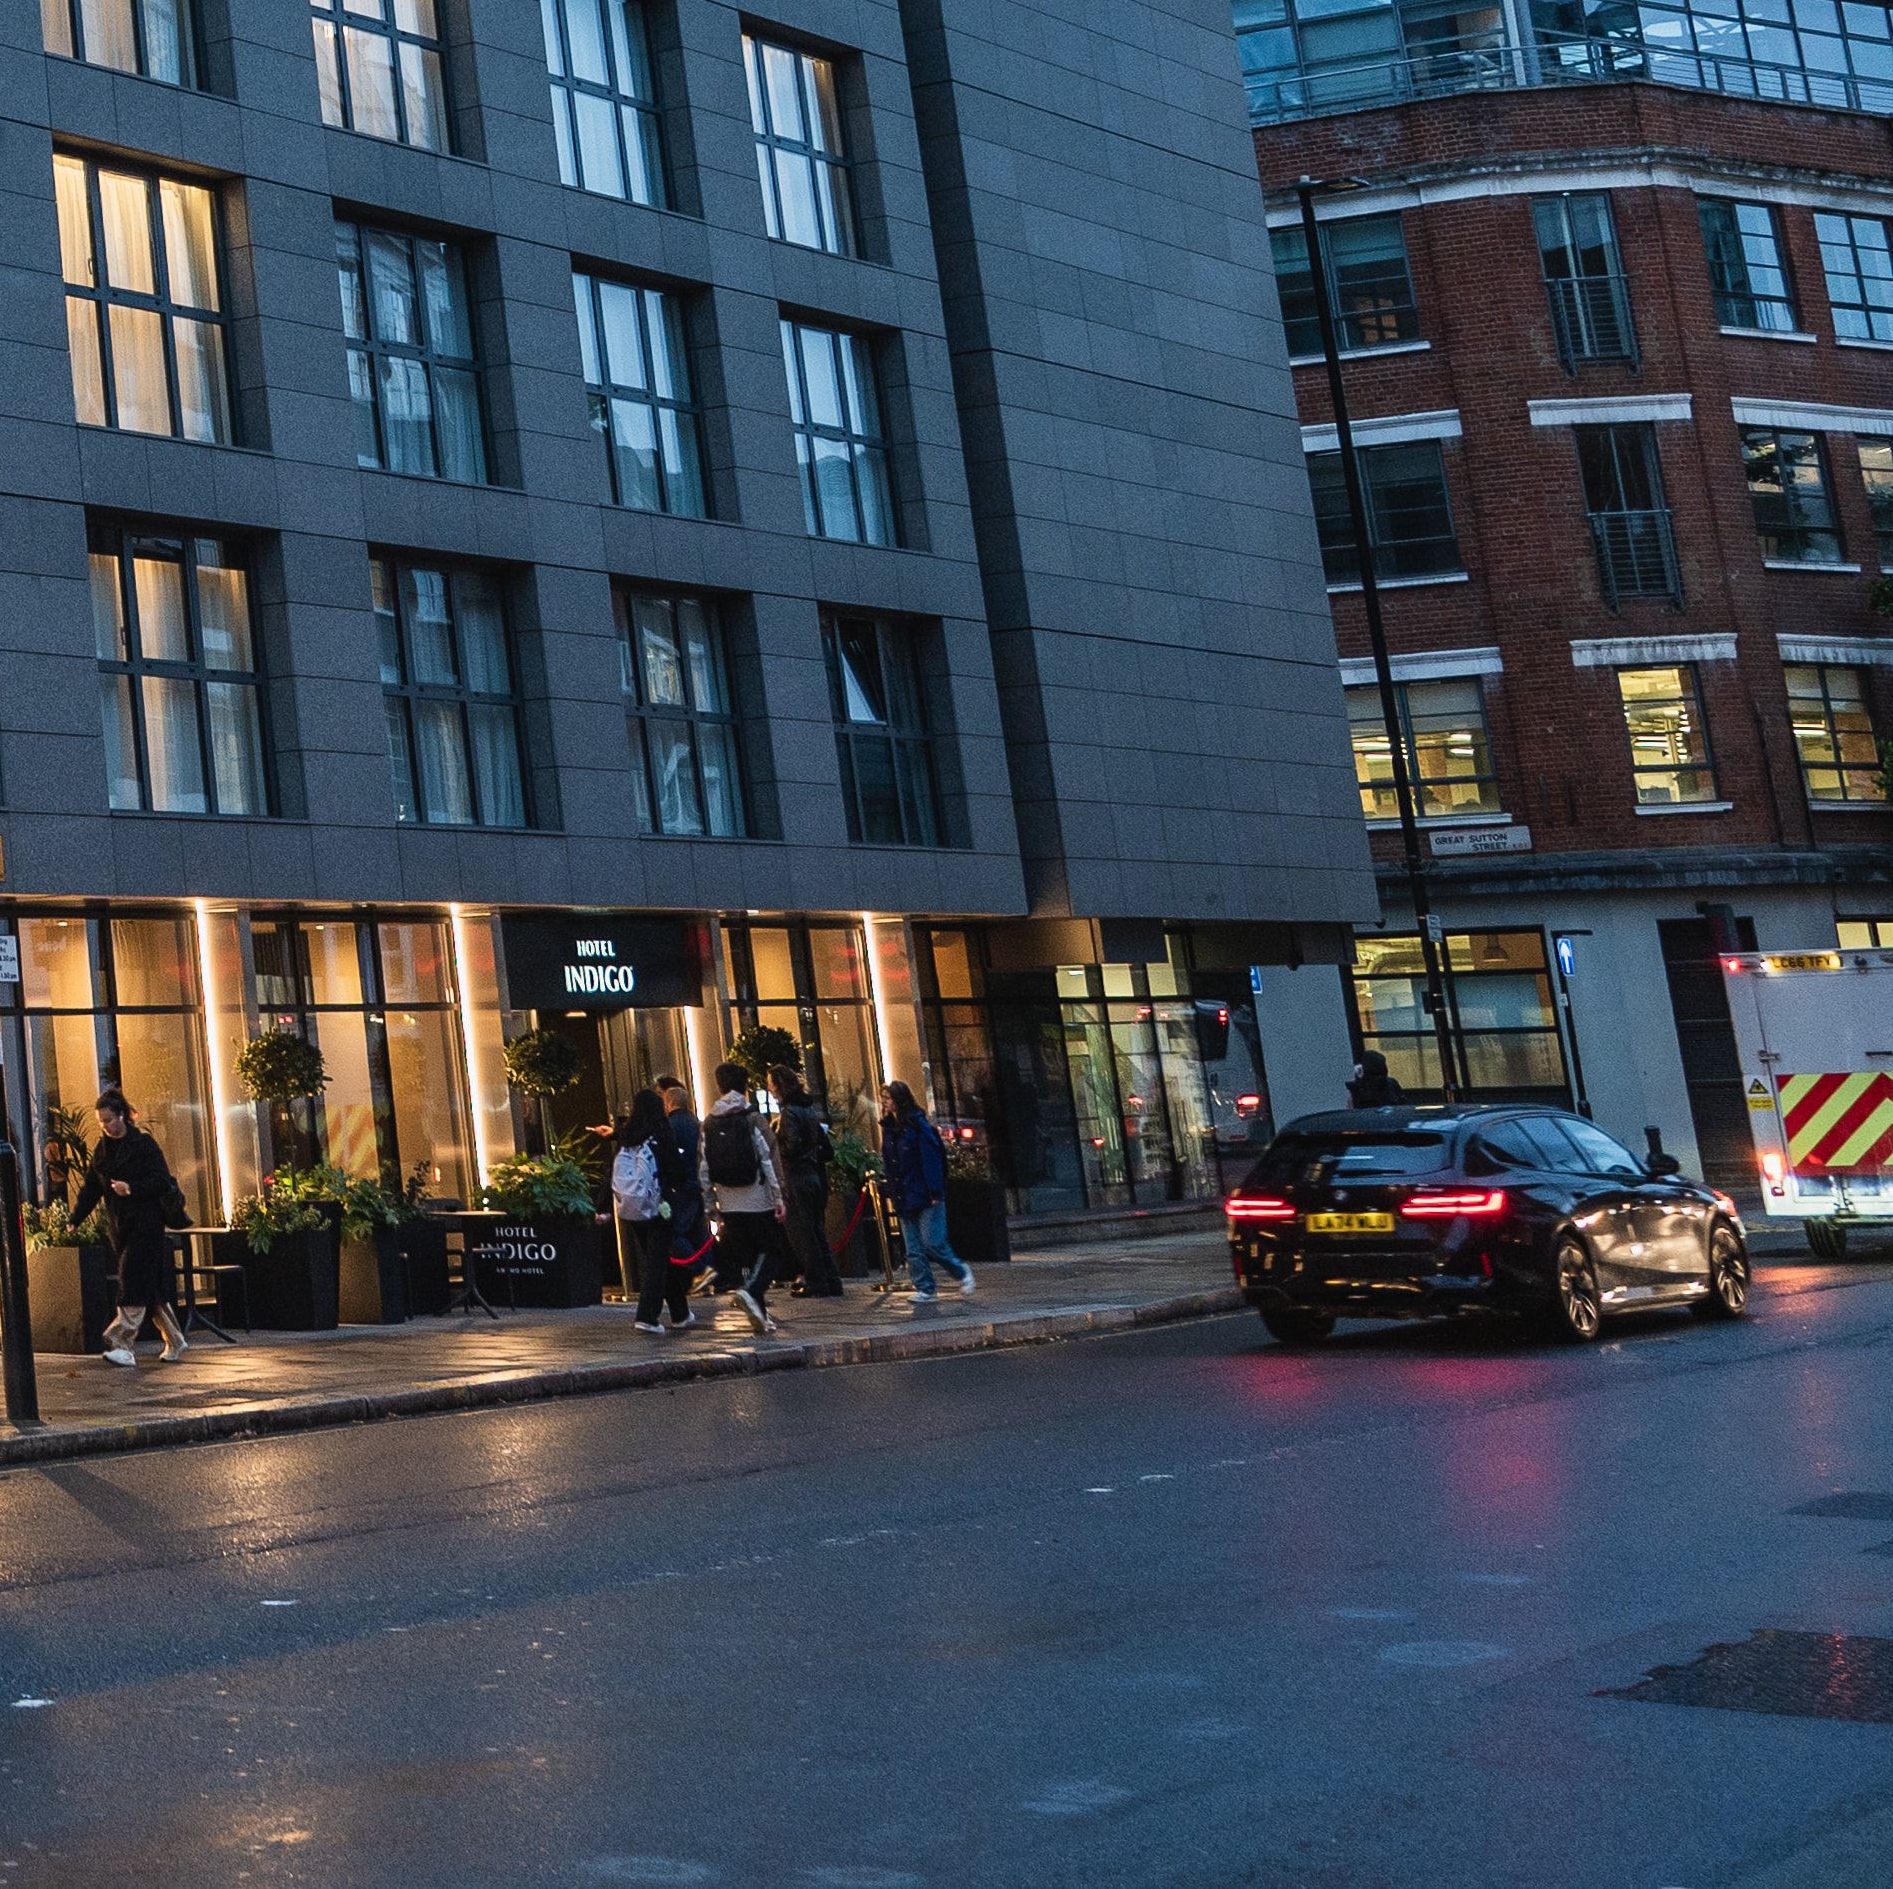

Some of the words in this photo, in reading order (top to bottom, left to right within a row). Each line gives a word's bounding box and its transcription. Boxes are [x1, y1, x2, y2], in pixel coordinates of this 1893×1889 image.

[1434, 836, 1465, 846] GREAT
[1469, 832, 1508, 844] SUTTON
[1472, 842, 1508, 852] STREET
[575, 939, 616, 958] HOTEL
[563, 965, 635, 993] INDIGO
[494, 1226, 538, 1238] HOTEL
